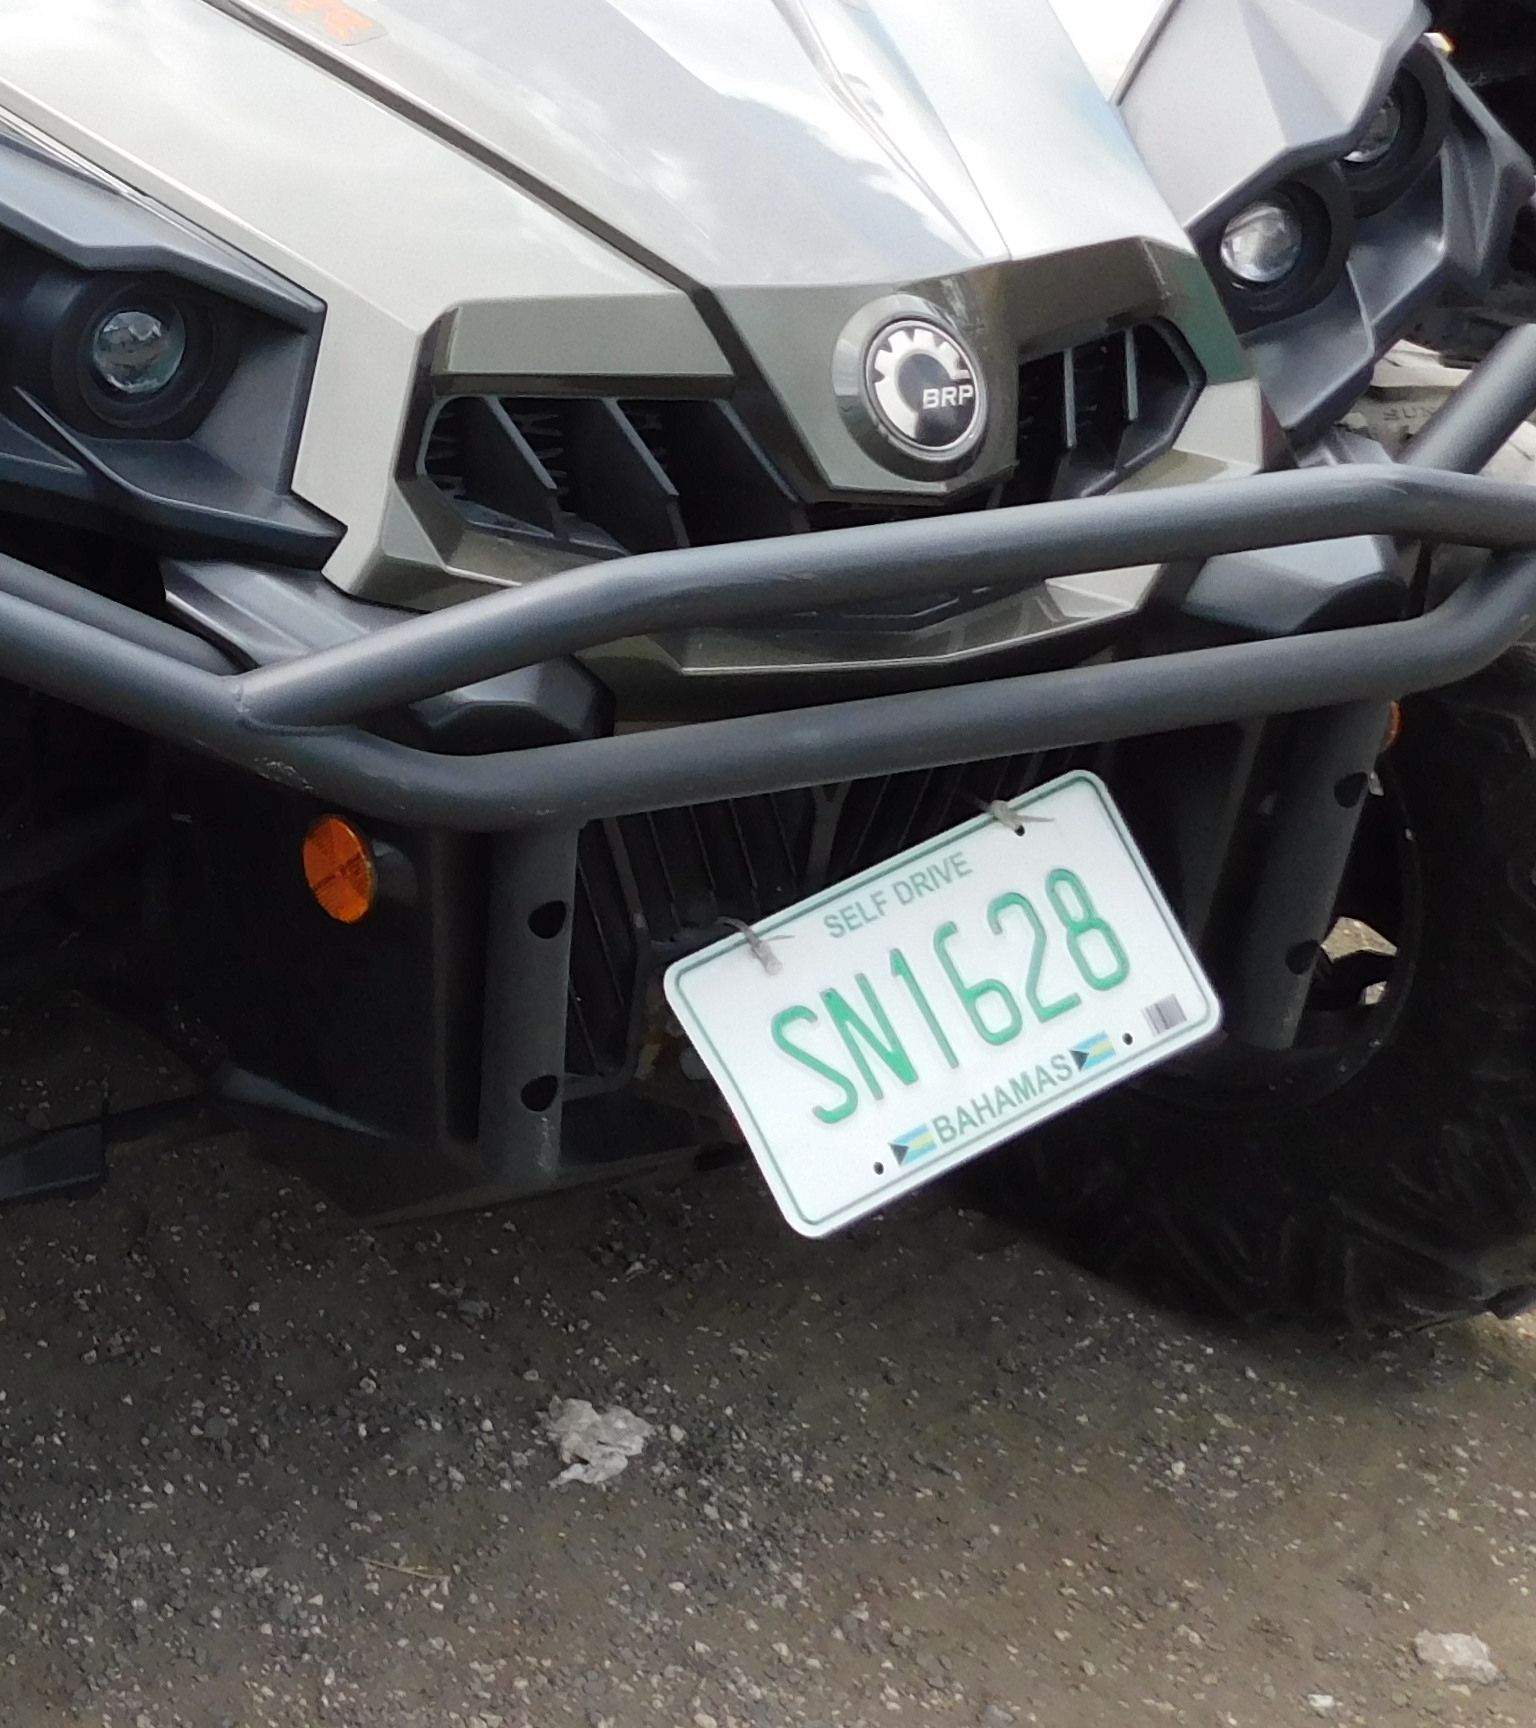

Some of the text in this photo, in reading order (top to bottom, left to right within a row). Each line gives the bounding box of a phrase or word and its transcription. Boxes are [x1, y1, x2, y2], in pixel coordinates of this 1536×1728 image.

[922, 384, 974, 410] BRP
[823, 851, 974, 940] SELF DRIVE
[770, 867, 1131, 1125] SN1628
[932, 1055, 1075, 1146] BAHAMAS
